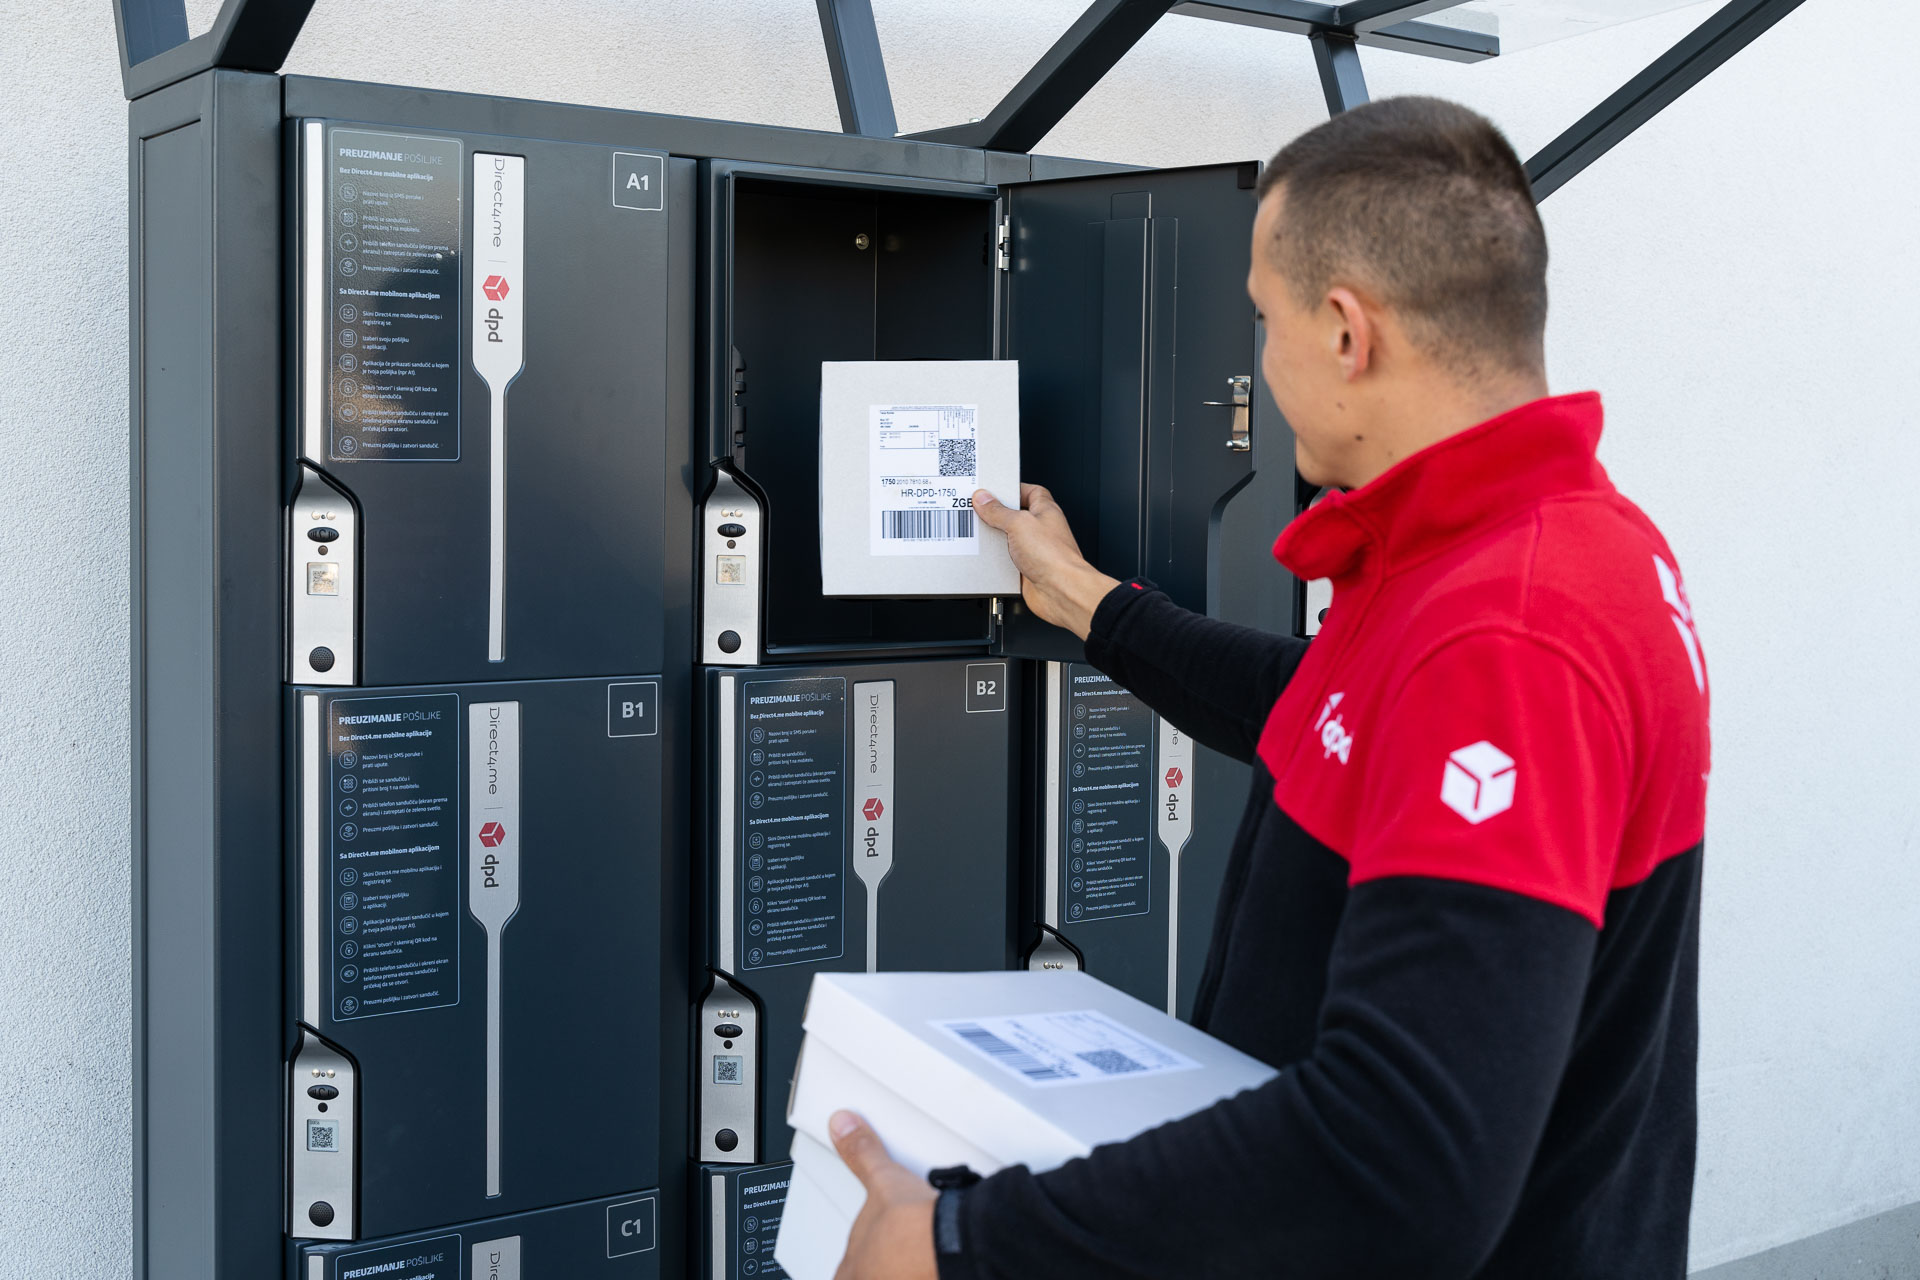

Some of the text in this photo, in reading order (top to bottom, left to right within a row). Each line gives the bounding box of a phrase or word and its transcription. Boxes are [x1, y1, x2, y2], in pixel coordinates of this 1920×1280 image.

[340, 148, 442, 164] PREUZIMANJE POŠILJKE
[351, 168, 382, 176] Direct4.me
[407, 173, 433, 182] aplikacije
[626, 173, 648, 190] A1
[492, 158, 505, 248] Direct4.me
[409, 292, 440, 300] aplikacijom
[484, 308, 504, 342] dpd
[901, 489, 956, 497] HR-DPD-1750
[976, 680, 996, 696] B2
[750, 692, 831, 704] PREUZIMANJE POŠILJKE
[339, 710, 441, 725] PREUZIMANJE POŠILJKE
[622, 702, 643, 718] B1
[803, 709, 824, 717] aplikacije
[350, 733, 382, 741] Direct4.me
[406, 730, 432, 739] aplikacije
[869, 694, 878, 774] Direct4.me
[487, 707, 500, 795] Direct4.me
[1166, 794, 1179, 821] dpd
[804, 812, 829, 821] aplikacijom
[864, 826, 880, 858] dpd
[348, 850, 379, 858] Direct4.me
[380, 847, 407, 855] mobilnom
[408, 844, 440, 854] aplikacijom
[481, 854, 500, 888] dpd
[621, 1218, 640, 1236] C1
[344, 1252, 444, 1280] PREUZIMANJE POŠILJKE
